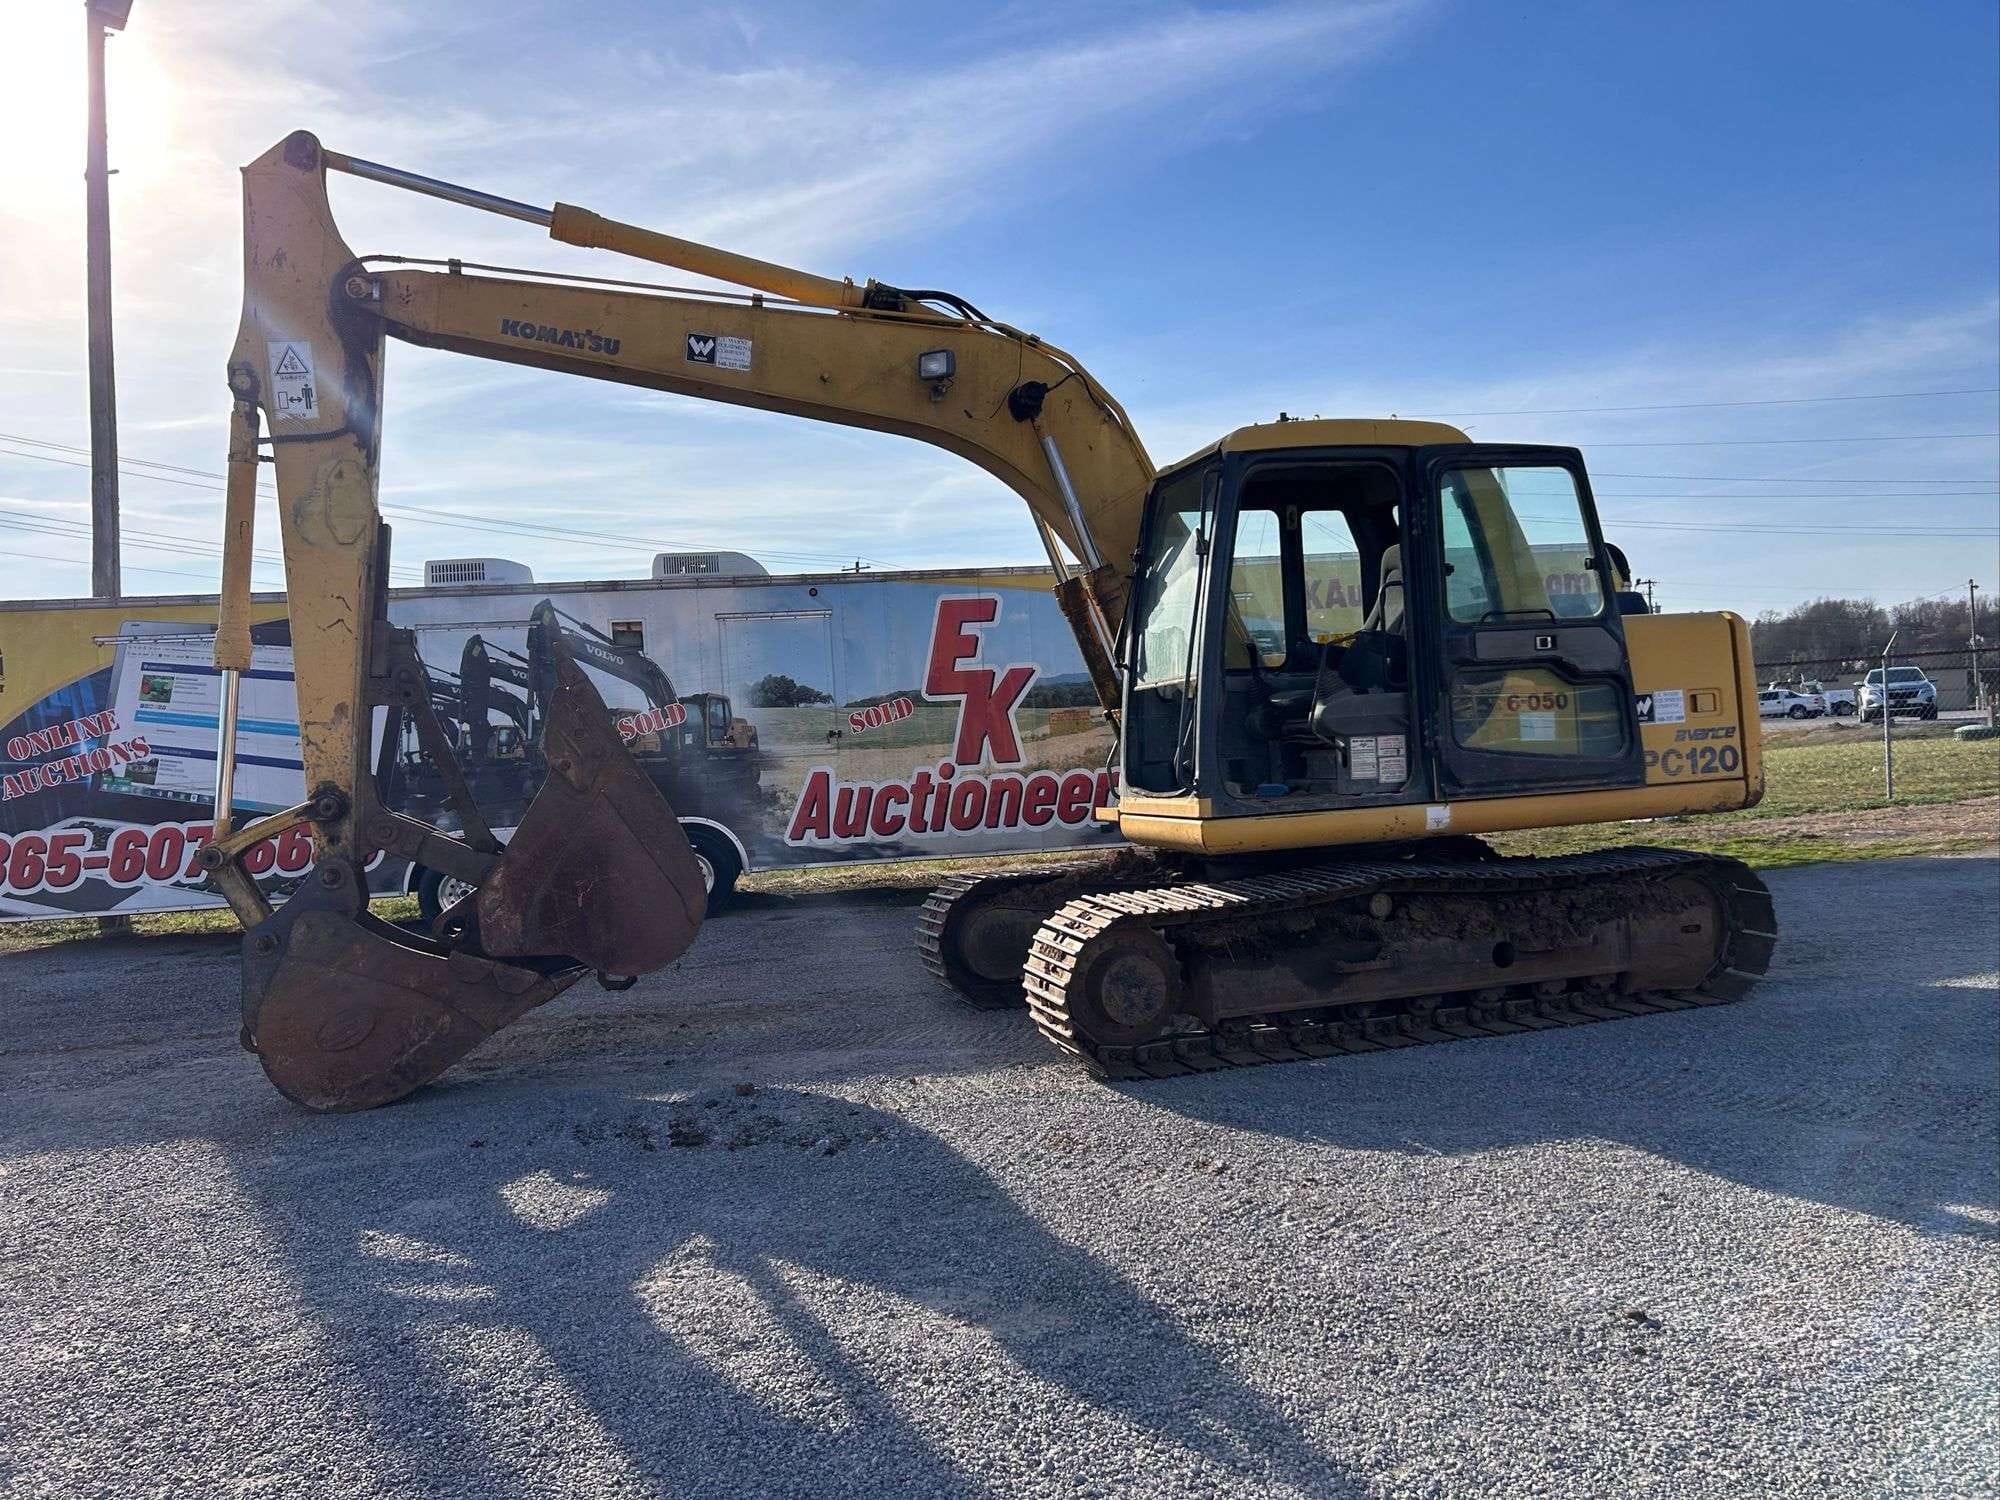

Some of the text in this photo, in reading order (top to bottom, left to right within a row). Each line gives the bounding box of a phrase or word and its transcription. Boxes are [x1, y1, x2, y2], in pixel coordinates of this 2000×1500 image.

[500, 318, 621, 356] KOMATSU
[585, 643, 625, 666] VOLVO
[617, 701, 687, 740] SOLD
[849, 697, 914, 733] SOLD
[7, 709, 120, 761] ONLINE
[1, 736, 152, 800] AUCTIONS
[1643, 745, 1739, 776] PC120
